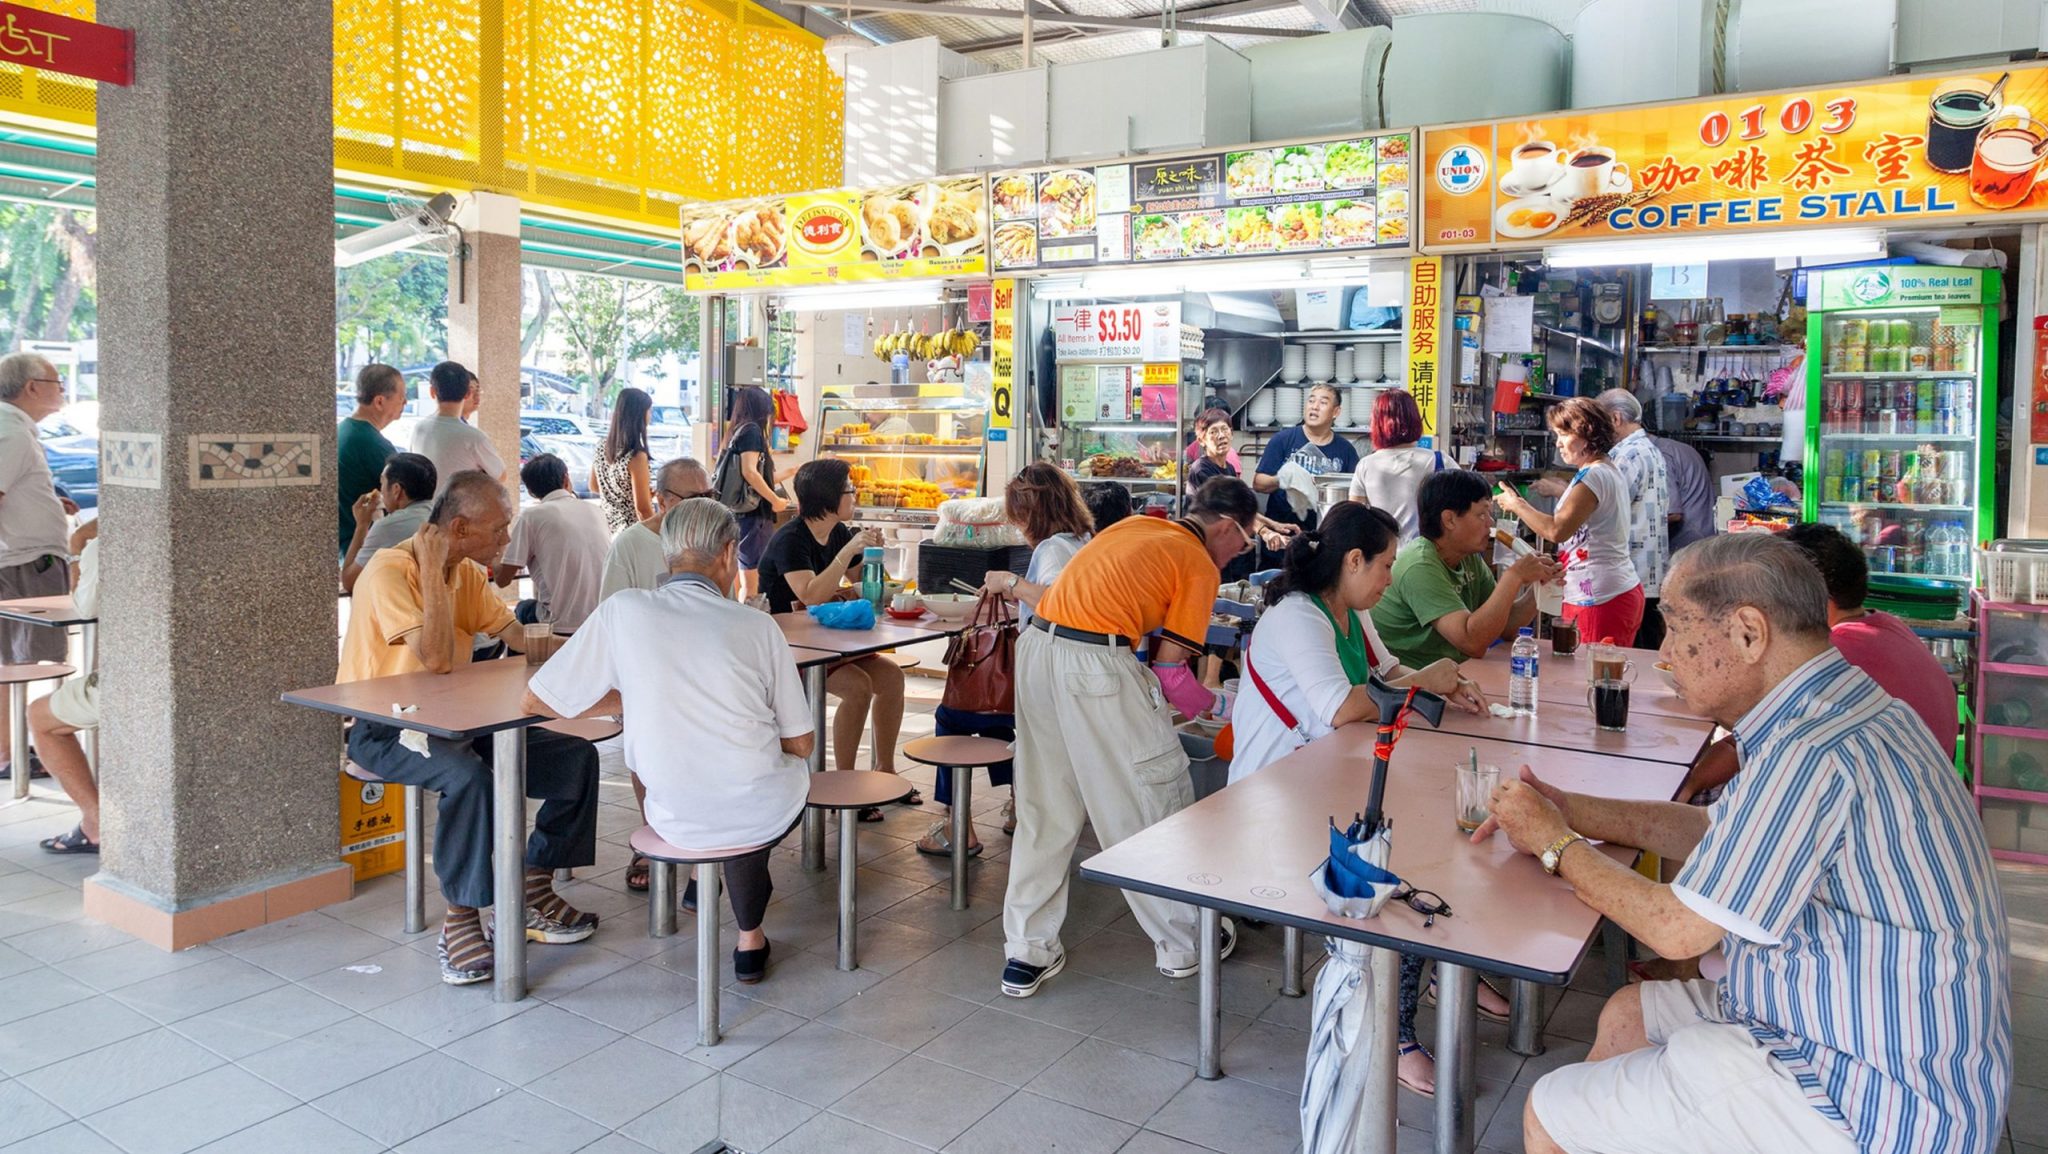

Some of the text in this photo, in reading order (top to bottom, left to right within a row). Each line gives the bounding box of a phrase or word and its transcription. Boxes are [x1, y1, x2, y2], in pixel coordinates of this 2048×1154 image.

[1699, 97, 1857, 147] 0103
[1441, 165, 1481, 176] UNION
[1639, 133, 1926, 193] 咖啡茶室
[1607, 186, 1956, 231] COFFEE STALL
[1440, 229, 1475, 239] #01-03
[1900, 278, 1926, 289] 100%
[1928, 276, 1949, 288] Real
[1952, 276, 1973, 287] Leaf
[995, 288, 1012, 310] Self
[1413, 261, 1437, 354] 自助服务
[1900, 293, 1933, 301] Premium
[994, 319, 1012, 340] Service
[1056, 308, 1142, 342] 一律 $3.50
[1057, 334, 1067, 343] All
[1151, 393, 1167, 412] A
